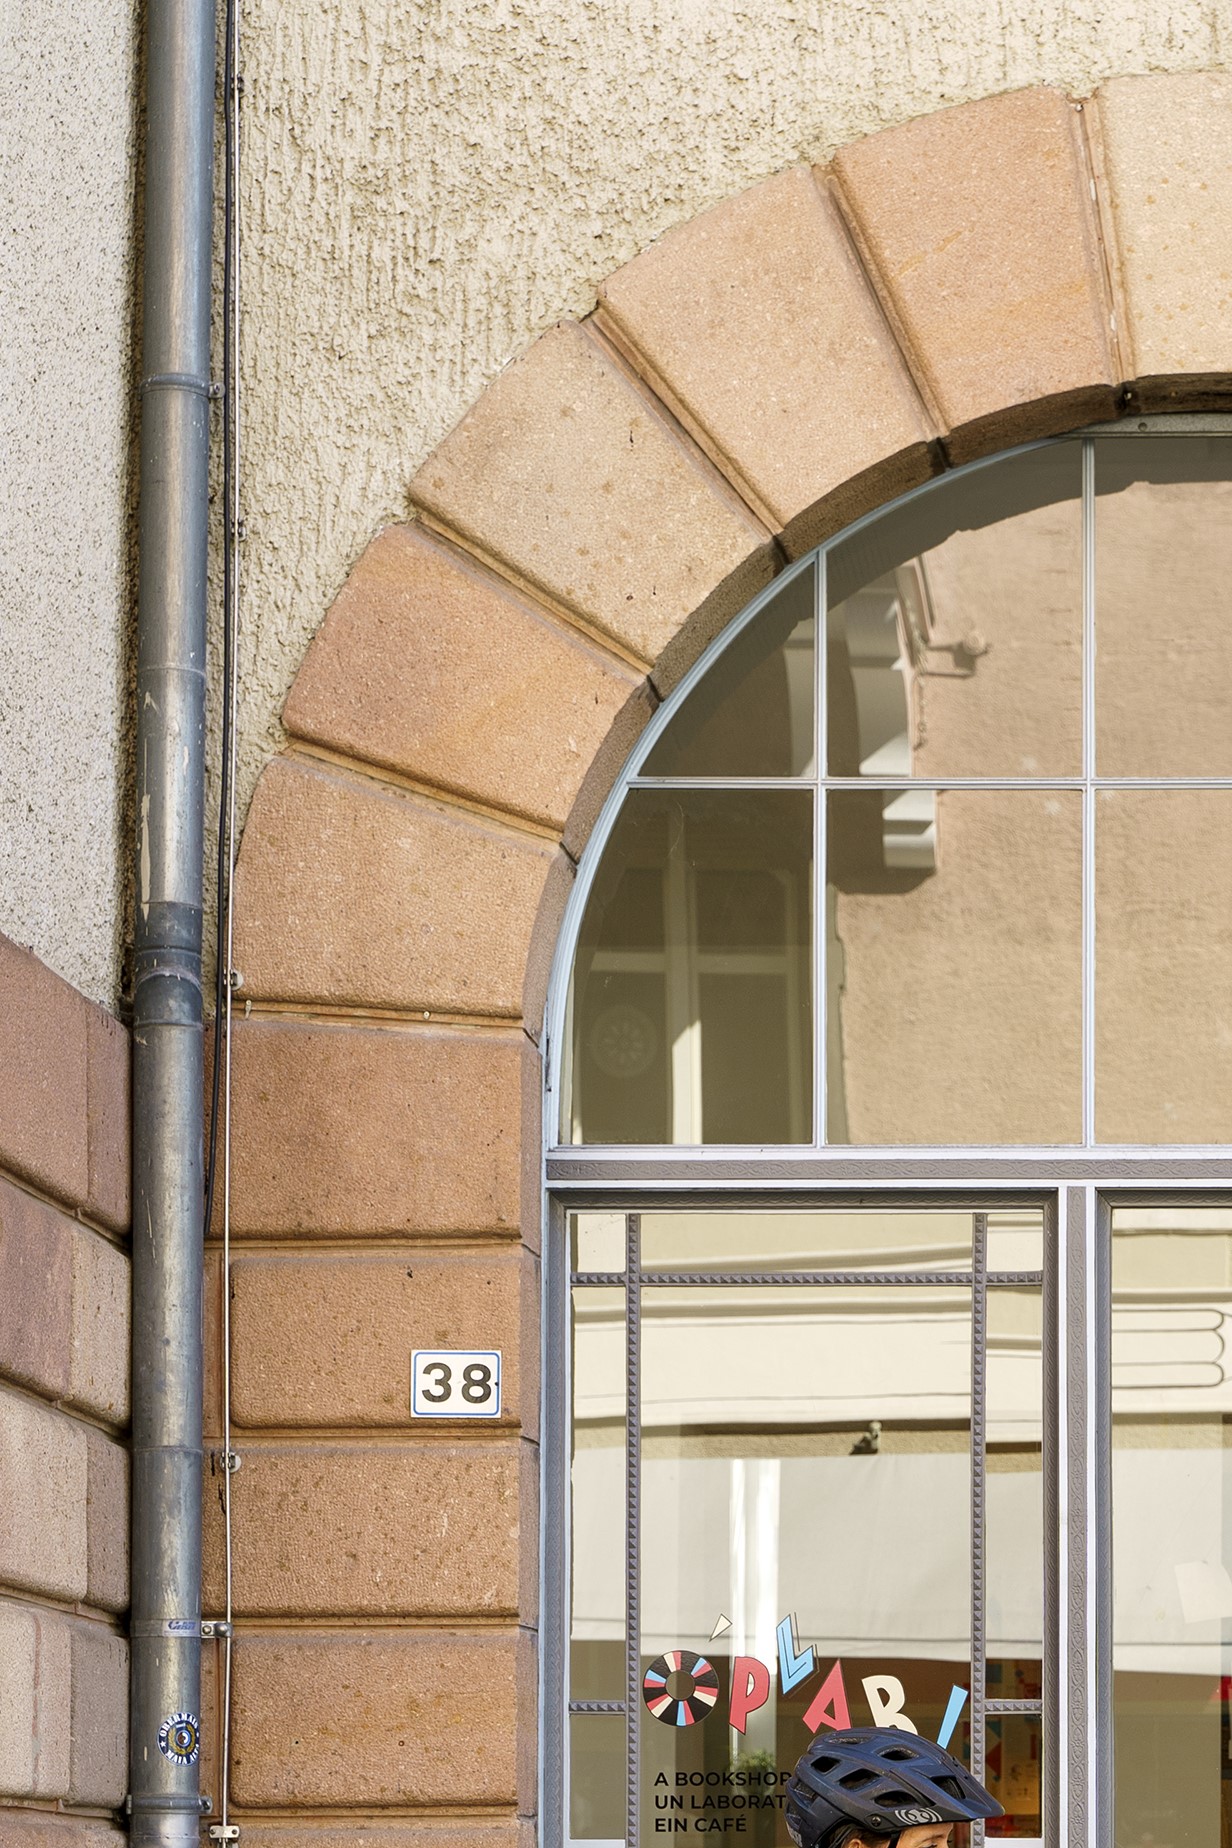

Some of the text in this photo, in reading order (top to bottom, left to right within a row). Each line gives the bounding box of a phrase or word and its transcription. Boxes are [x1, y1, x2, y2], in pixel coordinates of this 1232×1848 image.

[422, 1362, 492, 1404] 38
[654, 1772, 792, 1787] A BOOKSHOP
[655, 1795, 786, 1810] UN LABORAT
[655, 1814, 747, 1832] EIN CAFÉ
